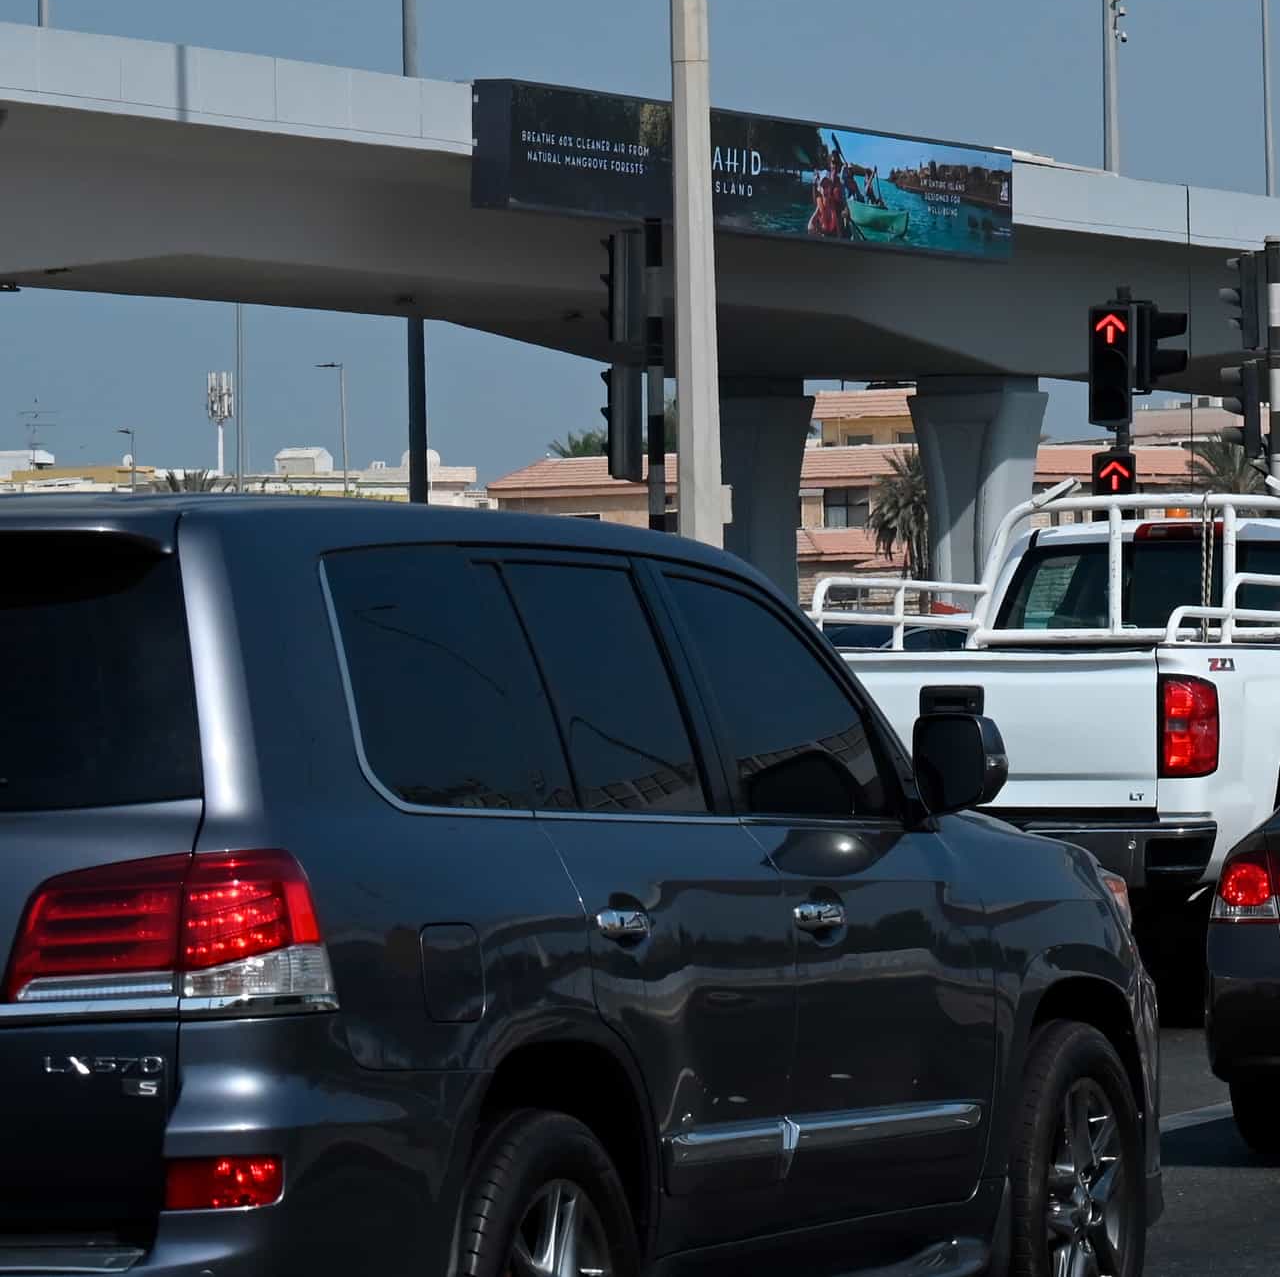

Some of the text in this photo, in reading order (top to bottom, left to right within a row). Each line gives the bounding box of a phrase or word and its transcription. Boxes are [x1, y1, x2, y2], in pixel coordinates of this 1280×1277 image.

[521, 130, 650, 157] BREATHE 60% CLEANER AIR FROM
[527, 150, 644, 175] NATURAL MANGROVE FORESTS
[712, 145, 761, 176] AHID
[715, 180, 753, 198] SLAND
[1129, 792, 1145, 801] LT
[138, 1080, 158, 1096] S
